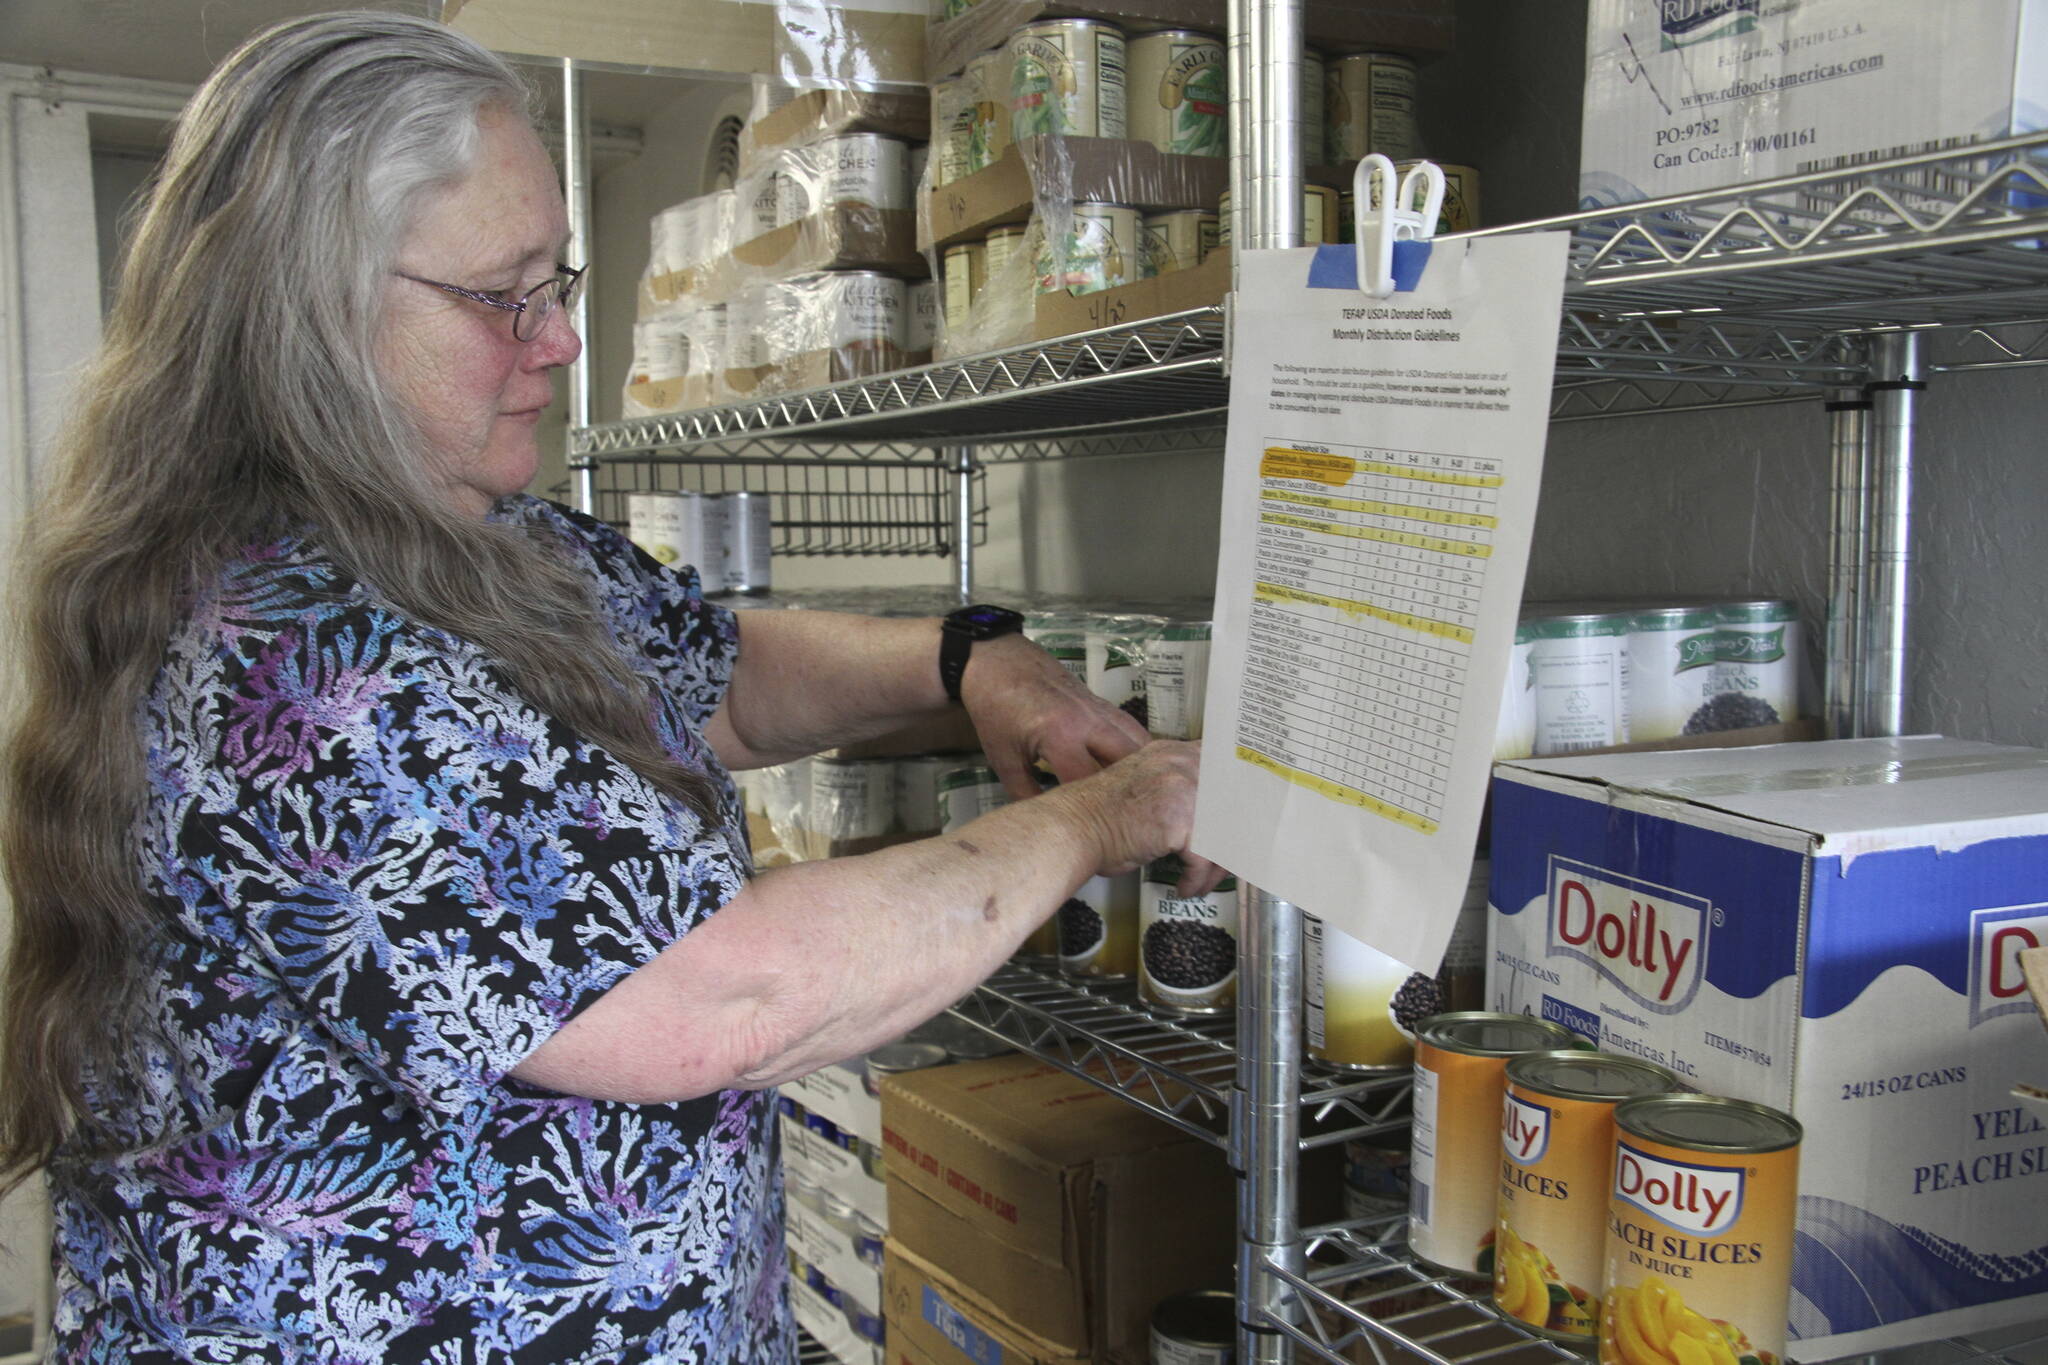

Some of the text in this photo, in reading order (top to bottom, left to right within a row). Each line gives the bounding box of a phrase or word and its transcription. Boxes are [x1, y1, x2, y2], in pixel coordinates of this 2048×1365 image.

[1680, 53, 1885, 107] www.rdfoodsamericas.com
[1655, 119, 1719, 147] PO:9782
[1653, 153, 1684, 170] Can
[1342, 307, 1452, 320] TEFAP USDA Donated Foods
[1333, 328, 1461, 343] Monthly Distribution Guidelines
[1158, 899, 1219, 919] BEANS
[1558, 879, 1693, 1001] Dolly
[1532, 966, 1561, 986] CANS
[1542, 998, 1559, 1020] RD
[1563, 1007, 1599, 1037] Foods
[1670, 1050, 1699, 1078] Inc.
[1841, 1066, 1967, 1100] 24/15 OZ CANS
[1912, 1151, 2013, 1194] PEACH
[1618, 1153, 1732, 1228] Dolly
[1662, 1235, 1763, 1264] SLICES
[1629, 1250, 1694, 1279] IN JUICE
